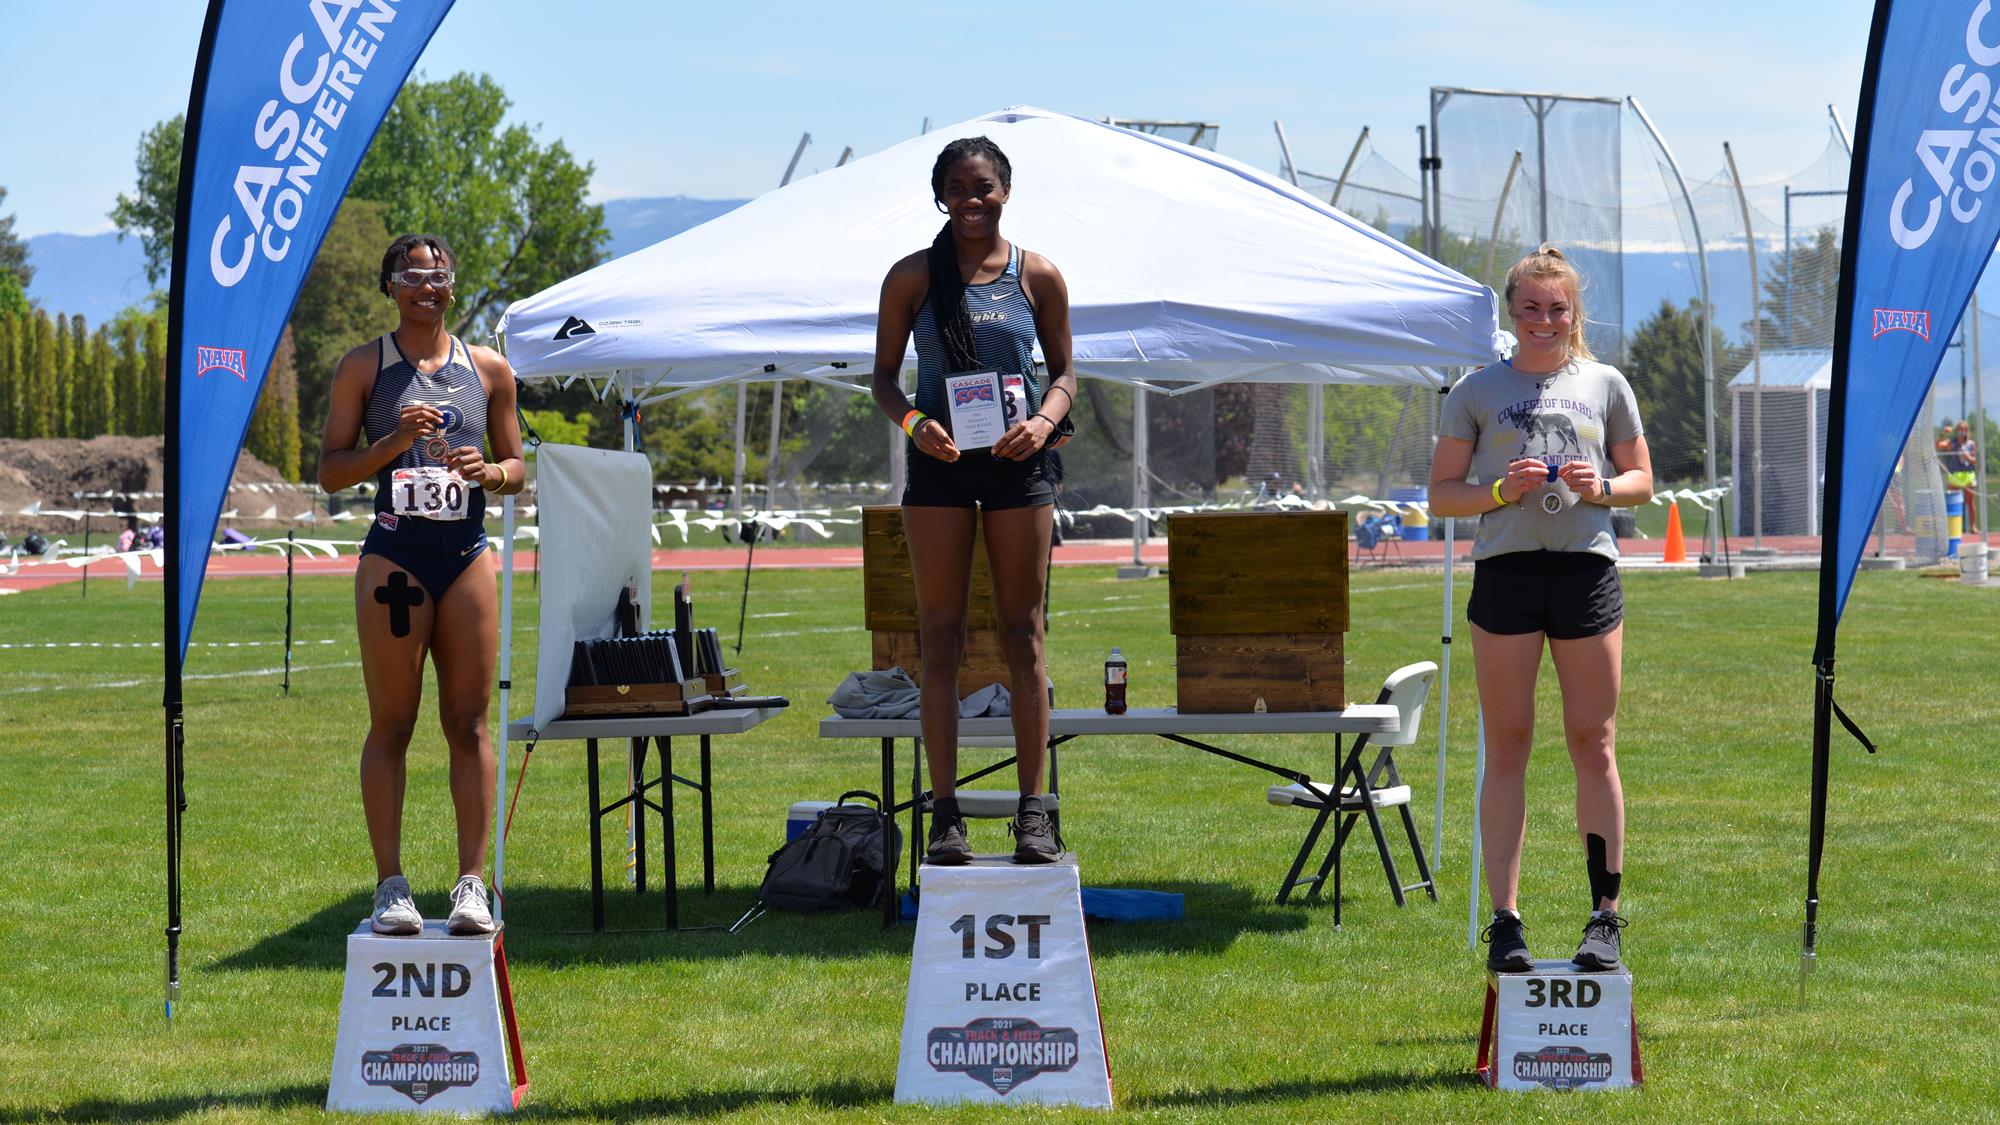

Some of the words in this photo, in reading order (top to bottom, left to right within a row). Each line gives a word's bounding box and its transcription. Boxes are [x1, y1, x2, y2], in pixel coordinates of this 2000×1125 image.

[261, 0, 403, 262] CONFEREN
[1950, 84, 2000, 224] CON
[1874, 309, 1929, 339] NAIA
[198, 347, 245, 378] NAIA
[952, 378, 991, 388] CASCADE
[956, 386, 992, 400] CCC
[1498, 399, 1542, 424] COLLEGE
[1545, 399, 1557, 408] OF
[1561, 399, 1592, 419] IDAHO
[1543, 455, 1561, 465] AND
[404, 483, 462, 511] 130
[950, 914, 1050, 959] 1ST
[372, 963, 472, 998] 2ND
[966, 982, 1041, 1001] PLACE
[1525, 979, 1602, 1008] 3RD
[392, 1016, 451, 1031] PLACE
[965, 1030, 997, 1040] TRACK
[1014, 1030, 1040, 1040] FIELD
[1539, 1024, 1588, 1035] PLACE
[930, 1042, 1076, 1065] CHAMPIONSHIP
[364, 1063, 477, 1081] CHAMPIONSHIP
[1515, 1062, 1610, 1077] CHAMPIONSHIP
